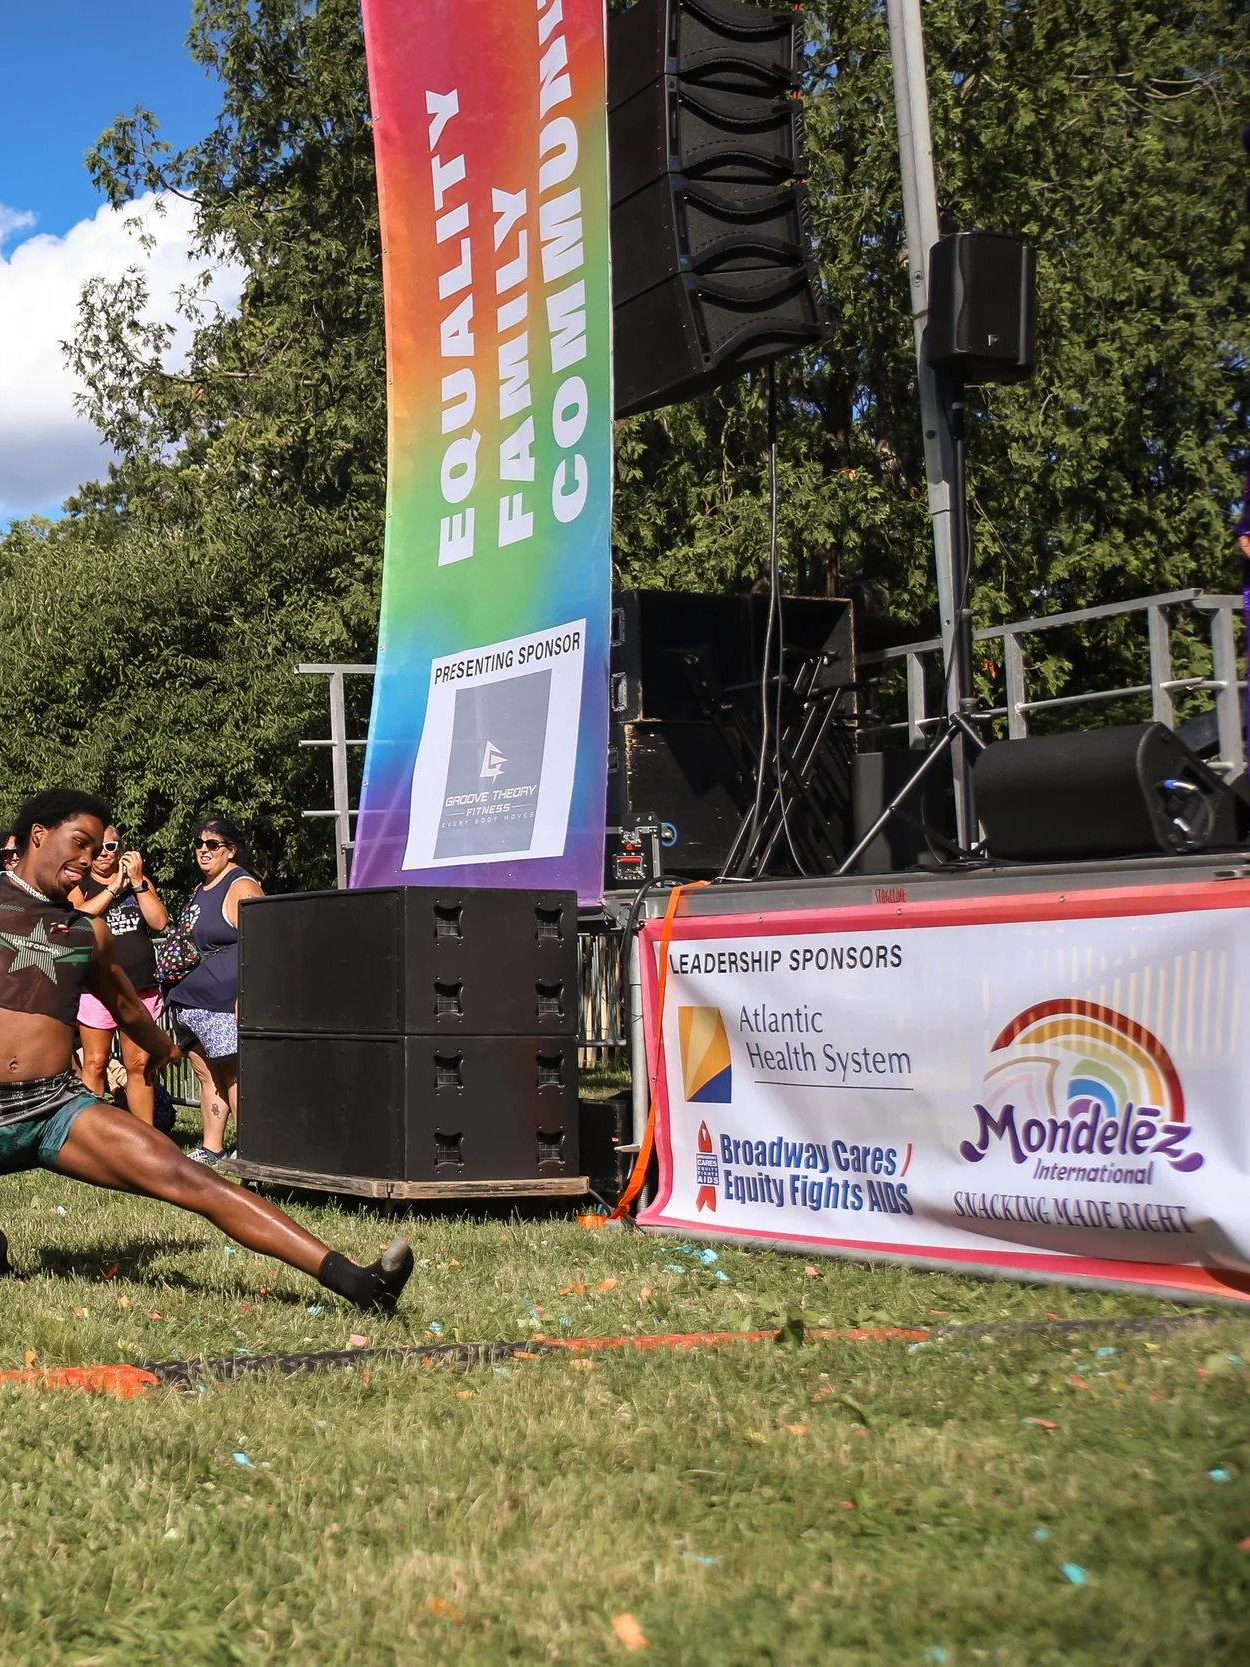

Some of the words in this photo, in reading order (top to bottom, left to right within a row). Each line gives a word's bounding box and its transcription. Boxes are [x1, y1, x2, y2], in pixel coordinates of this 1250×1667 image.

[536, 0, 588, 524] COMMUNI
[425, 88, 481, 567] EQUALITY
[491, 187, 535, 548] FAMILY
[434, 650, 514, 685] PRESENTING
[517, 631, 581, 665] SPONSOR
[445, 791, 490, 807] GROOVE
[492, 784, 538, 801] THEORY
[466, 803, 511, 817] FITNESS
[106, 913, 127, 923] LIVE
[12, 938, 60, 955] CALIFORNIA
[669, 949, 782, 975] LEADERSHIP
[788, 944, 903, 971] SPONSORS
[739, 1004, 824, 1034] Atlantic
[745, 1041, 818, 1072] Health
[824, 1045, 913, 1082] System
[697, 1159, 718, 1167] CARES
[719, 1133, 831, 1175] Broadway
[697, 1175, 719, 1185] AIDS
[1032, 1157, 1154, 1186] International
[723, 1167, 786, 1208] Equity
[789, 1175, 863, 1212] Fights
[867, 1181, 914, 1216] AIDS
[953, 1190, 1051, 1225] SNACKING
[1052, 1197, 1115, 1229] MADE
[1116, 1202, 1196, 1234] RIGHT
